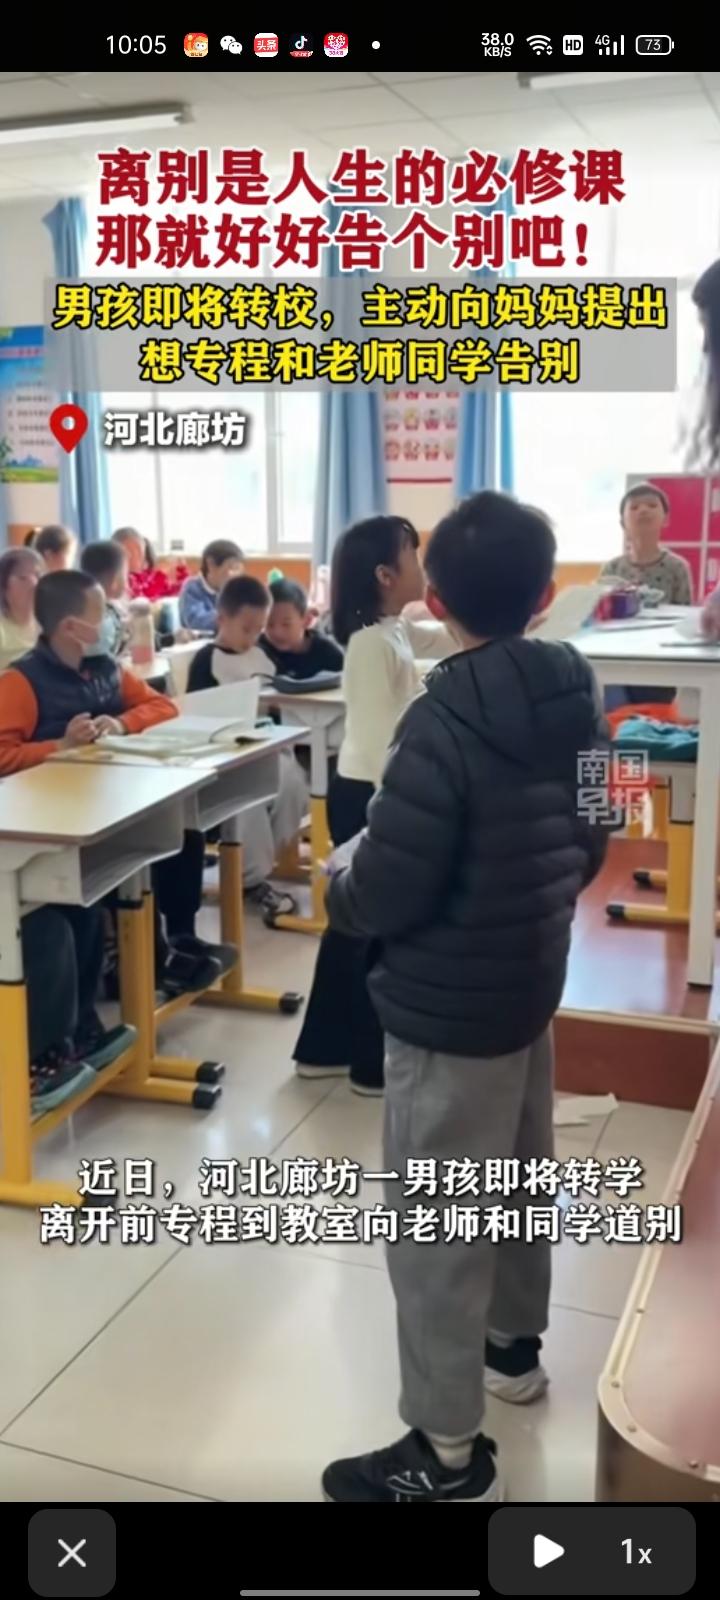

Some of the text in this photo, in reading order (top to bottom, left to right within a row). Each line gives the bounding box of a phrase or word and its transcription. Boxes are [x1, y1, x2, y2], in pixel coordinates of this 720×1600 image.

[106, 35, 167, 54] 10:05
[481, 32, 515, 46] 38.0
[565, 39, 582, 51] HD
[594, 34, 610, 46] 4G
[645, 38, 661, 51] 73
[256, 40, 277, 51] 头条
[484, 47, 512, 57] KB/S
[621, 1538, 653, 1565] 1x
